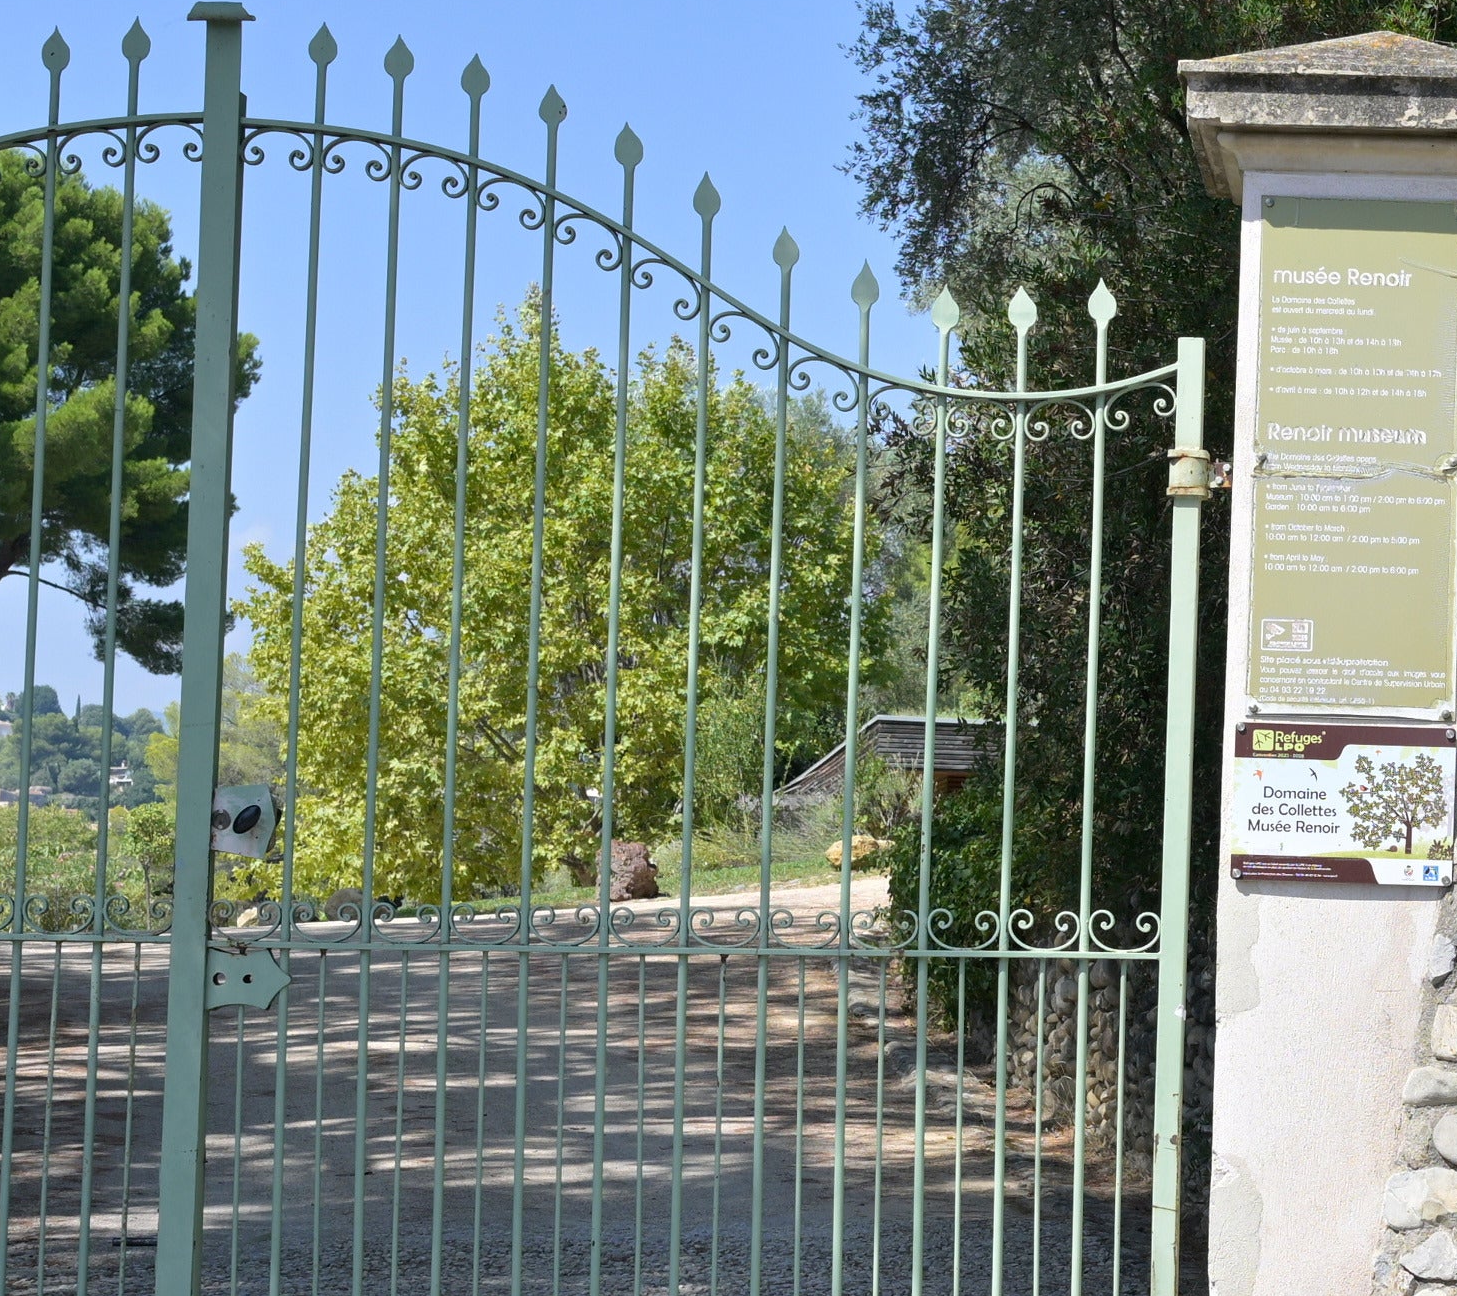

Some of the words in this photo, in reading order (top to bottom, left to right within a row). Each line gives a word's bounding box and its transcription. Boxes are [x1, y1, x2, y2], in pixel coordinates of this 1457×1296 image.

[1273, 266, 1341, 285] musée
[1347, 268, 1413, 287] Renoir
[1267, 422, 1333, 443] Renoir
[1338, 425, 1428, 445] museum
[1275, 730, 1322, 745] Refuges
[1275, 743, 1305, 752] LPO
[1263, 785, 1327, 800] Domaine
[1251, 803, 1274, 815] des
[1278, 803, 1337, 817] Collettes
[1247, 819, 1291, 833] Musée
[1295, 820, 1340, 834] Renoir
